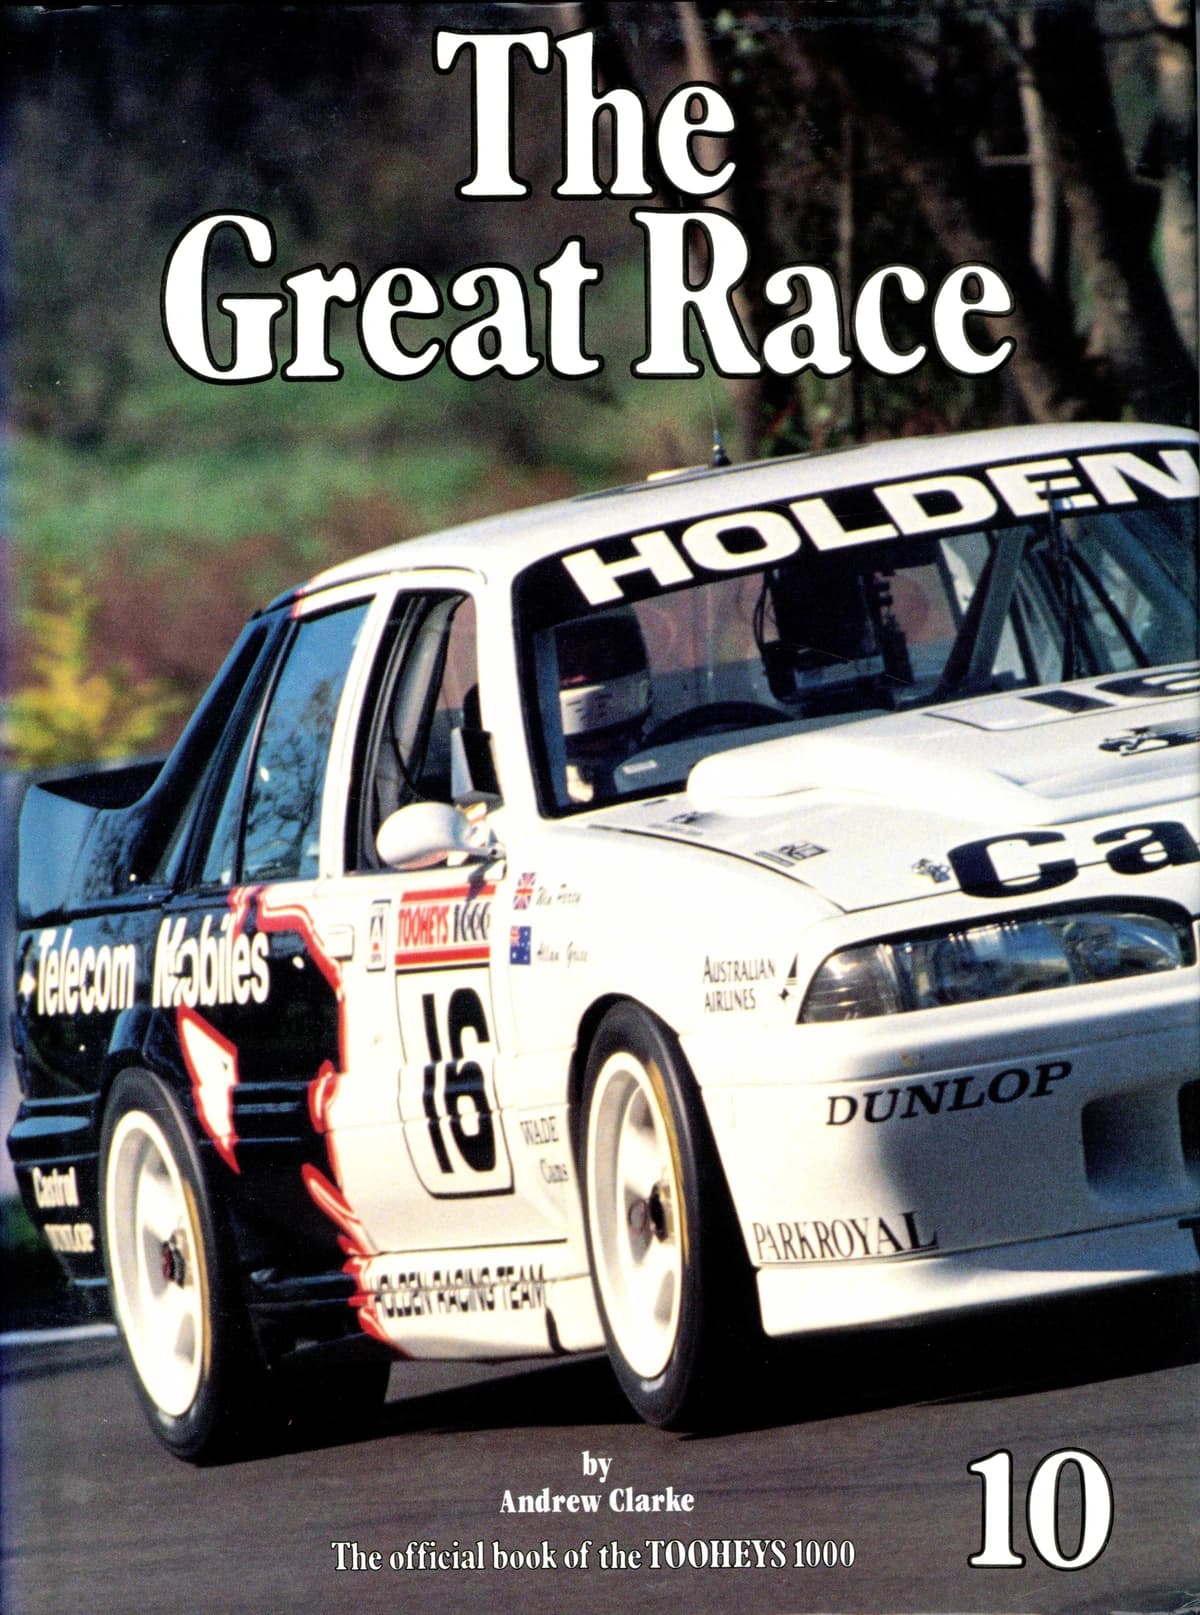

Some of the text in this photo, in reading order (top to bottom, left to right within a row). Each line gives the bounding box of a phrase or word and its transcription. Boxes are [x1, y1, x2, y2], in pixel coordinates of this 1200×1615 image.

[561, 449, 1199, 607] HOLDEN
[398, 905, 450, 948] TOOHEYS
[36, 913, 270, 1016] Telecom Mobiles
[703, 955, 776, 984] AUSTRALIAN
[703, 987, 757, 1013] AIRLINES
[421, 986, 497, 1175] 16
[826, 1060, 1073, 1127] DUNLOP
[519, 1115, 560, 1147] WADE
[751, 1210, 939, 1263] PARKROYAL
